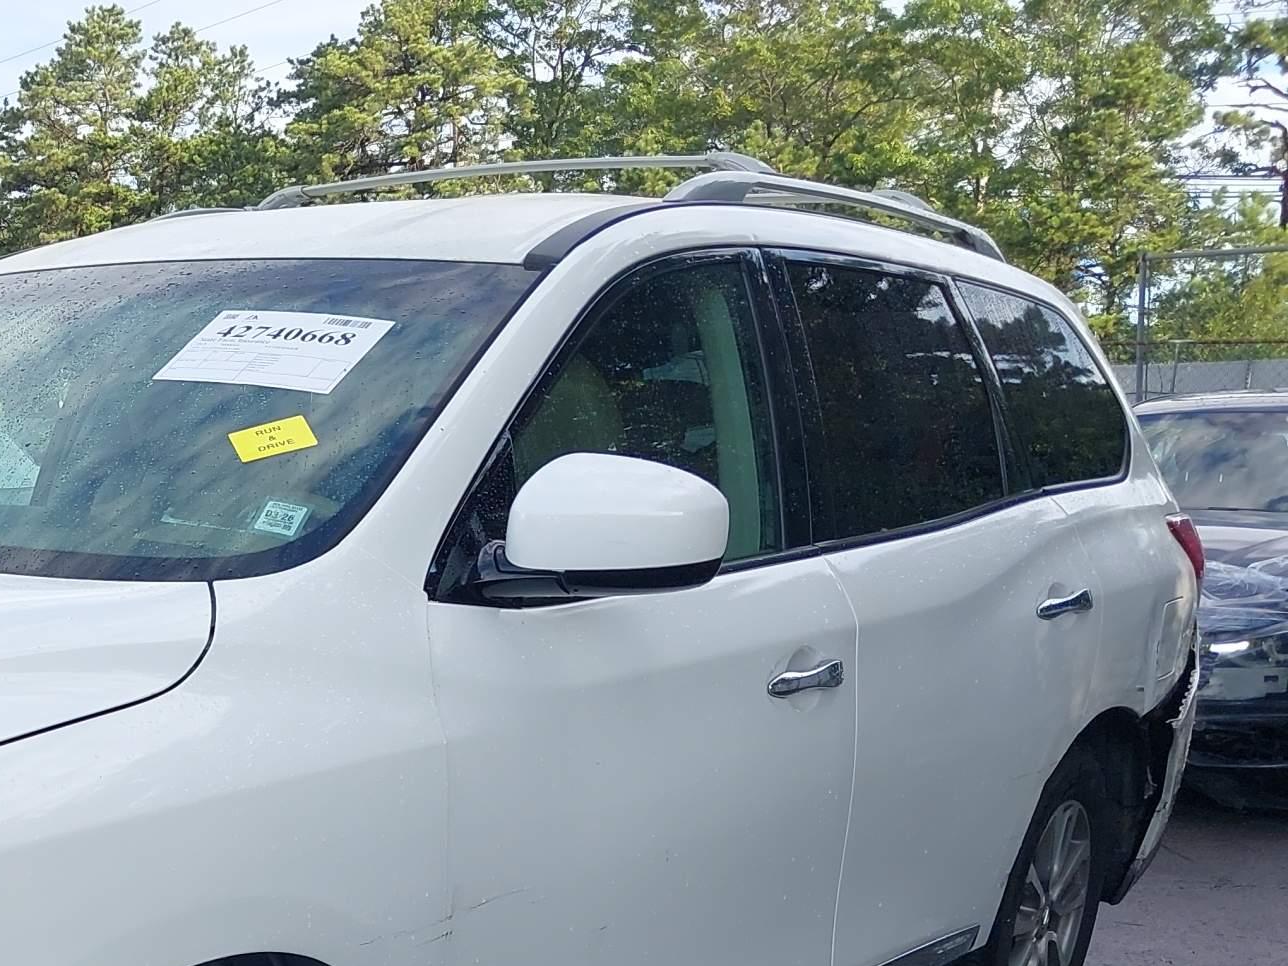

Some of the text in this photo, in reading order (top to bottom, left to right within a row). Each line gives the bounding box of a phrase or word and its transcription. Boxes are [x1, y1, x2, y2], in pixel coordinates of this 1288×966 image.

[216, 324, 357, 346] 42740668
[255, 425, 282, 436] RUN
[257, 438, 295, 452] DRIVE
